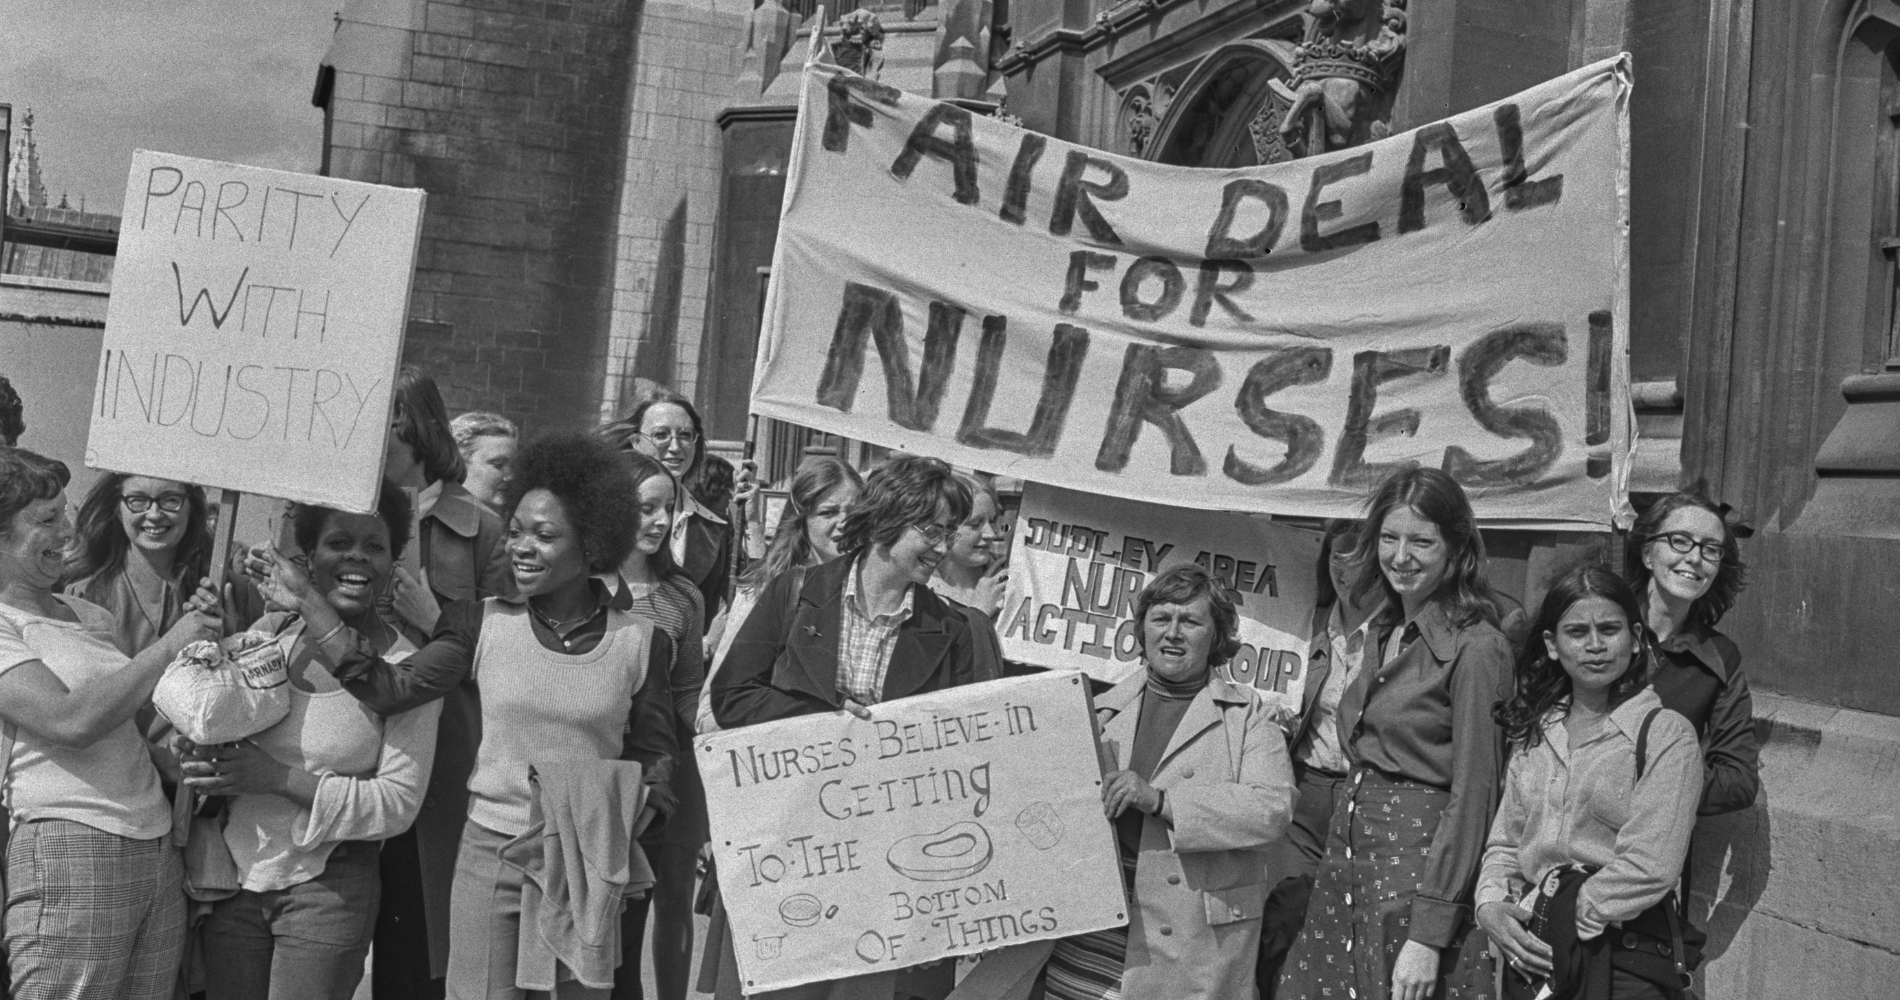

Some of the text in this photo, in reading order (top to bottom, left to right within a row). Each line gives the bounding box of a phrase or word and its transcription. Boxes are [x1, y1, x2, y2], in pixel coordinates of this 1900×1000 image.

[822, 71, 1564, 259] FAIR DEAL
[141, 165, 371, 258] PARITY
[171, 261, 331, 343] WITH
[1059, 249, 1255, 328] FOR
[101, 349, 382, 450] INDUSTRY
[815, 280, 1613, 487] NURSES!
[1025, 517, 1175, 574] DUDLEY
[1004, 596, 1150, 666] ACTIO
[726, 702, 1039, 788] NURSES BELiEVE in
[818, 761, 991, 820] GETTing
[737, 834, 862, 888] TO THE
[889, 879, 1008, 921] BOTTOM
[855, 906, 1058, 965] OF THInGS
